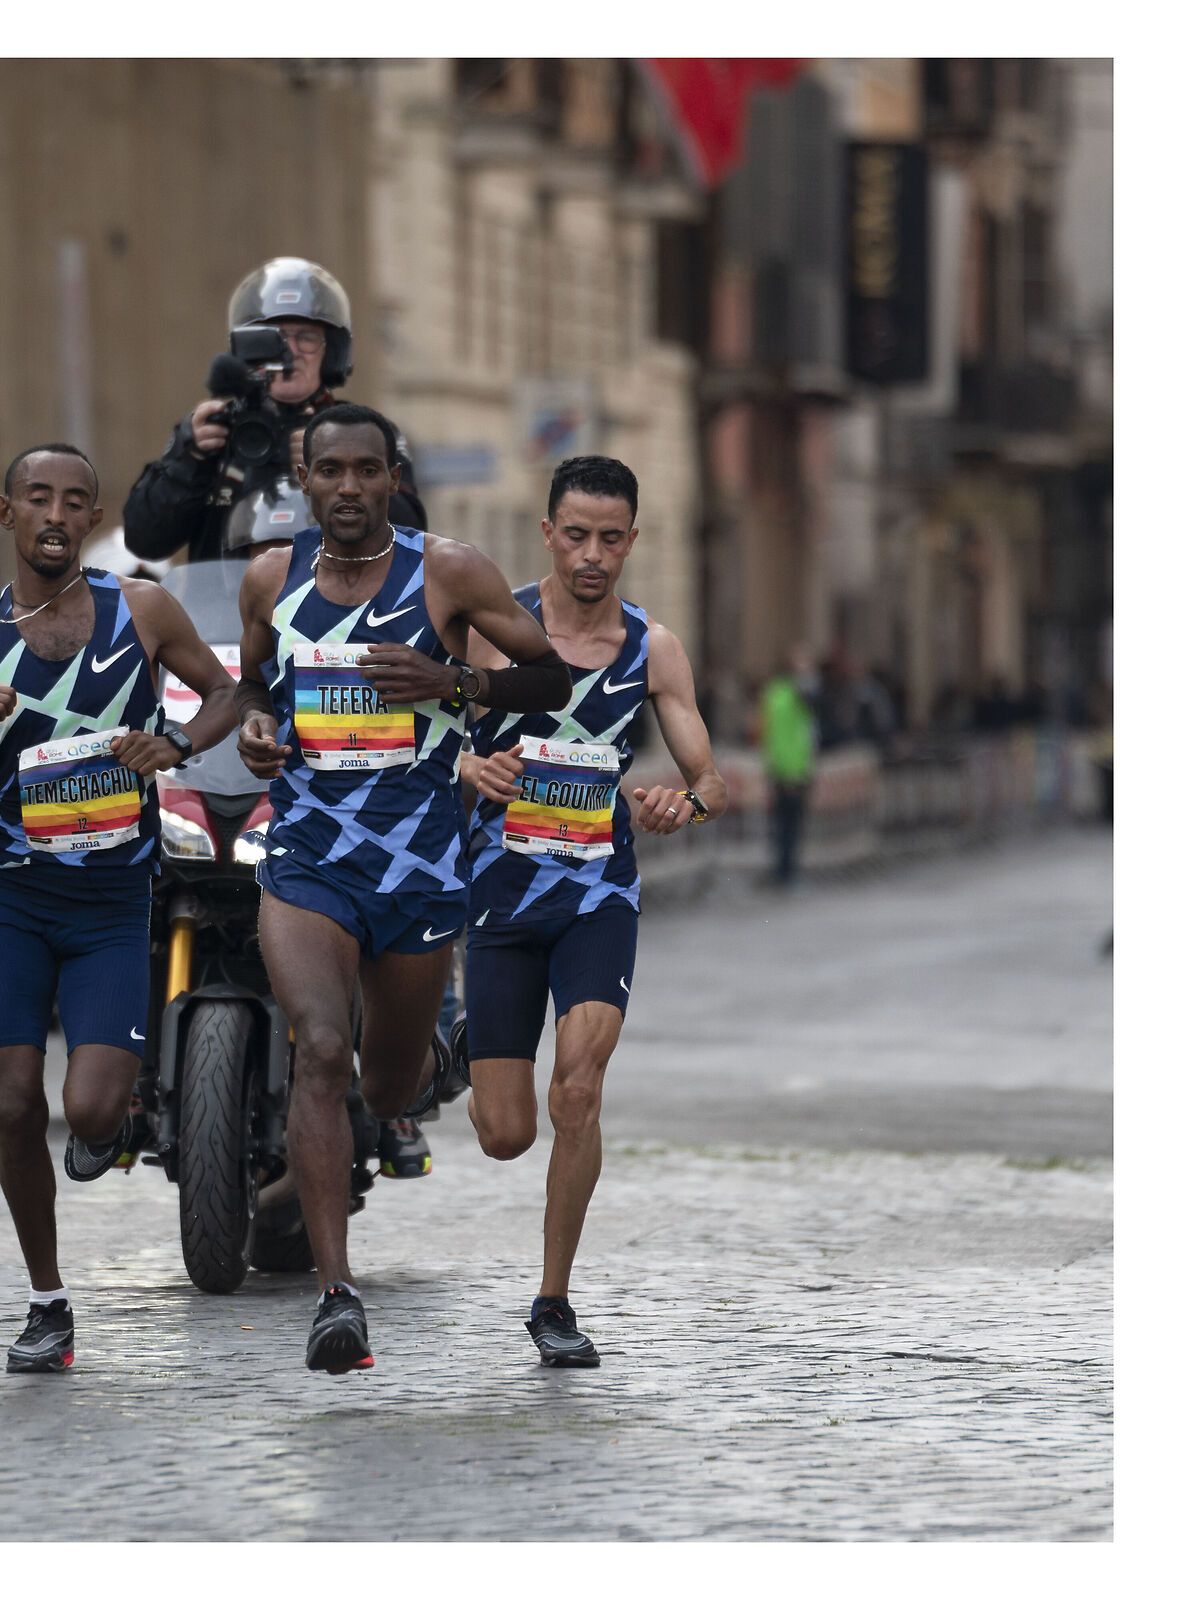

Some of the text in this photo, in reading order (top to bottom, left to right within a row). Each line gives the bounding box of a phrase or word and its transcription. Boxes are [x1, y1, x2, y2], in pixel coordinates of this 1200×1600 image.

[317, 685, 389, 715] TEFERA
[348, 733, 357, 747] 11
[569, 751, 608, 765] acea
[23, 766, 134, 805] TEMECHACHU
[518, 775, 540, 804] EL
[77, 817, 89, 830] 12
[558, 823, 569, 837] 13
